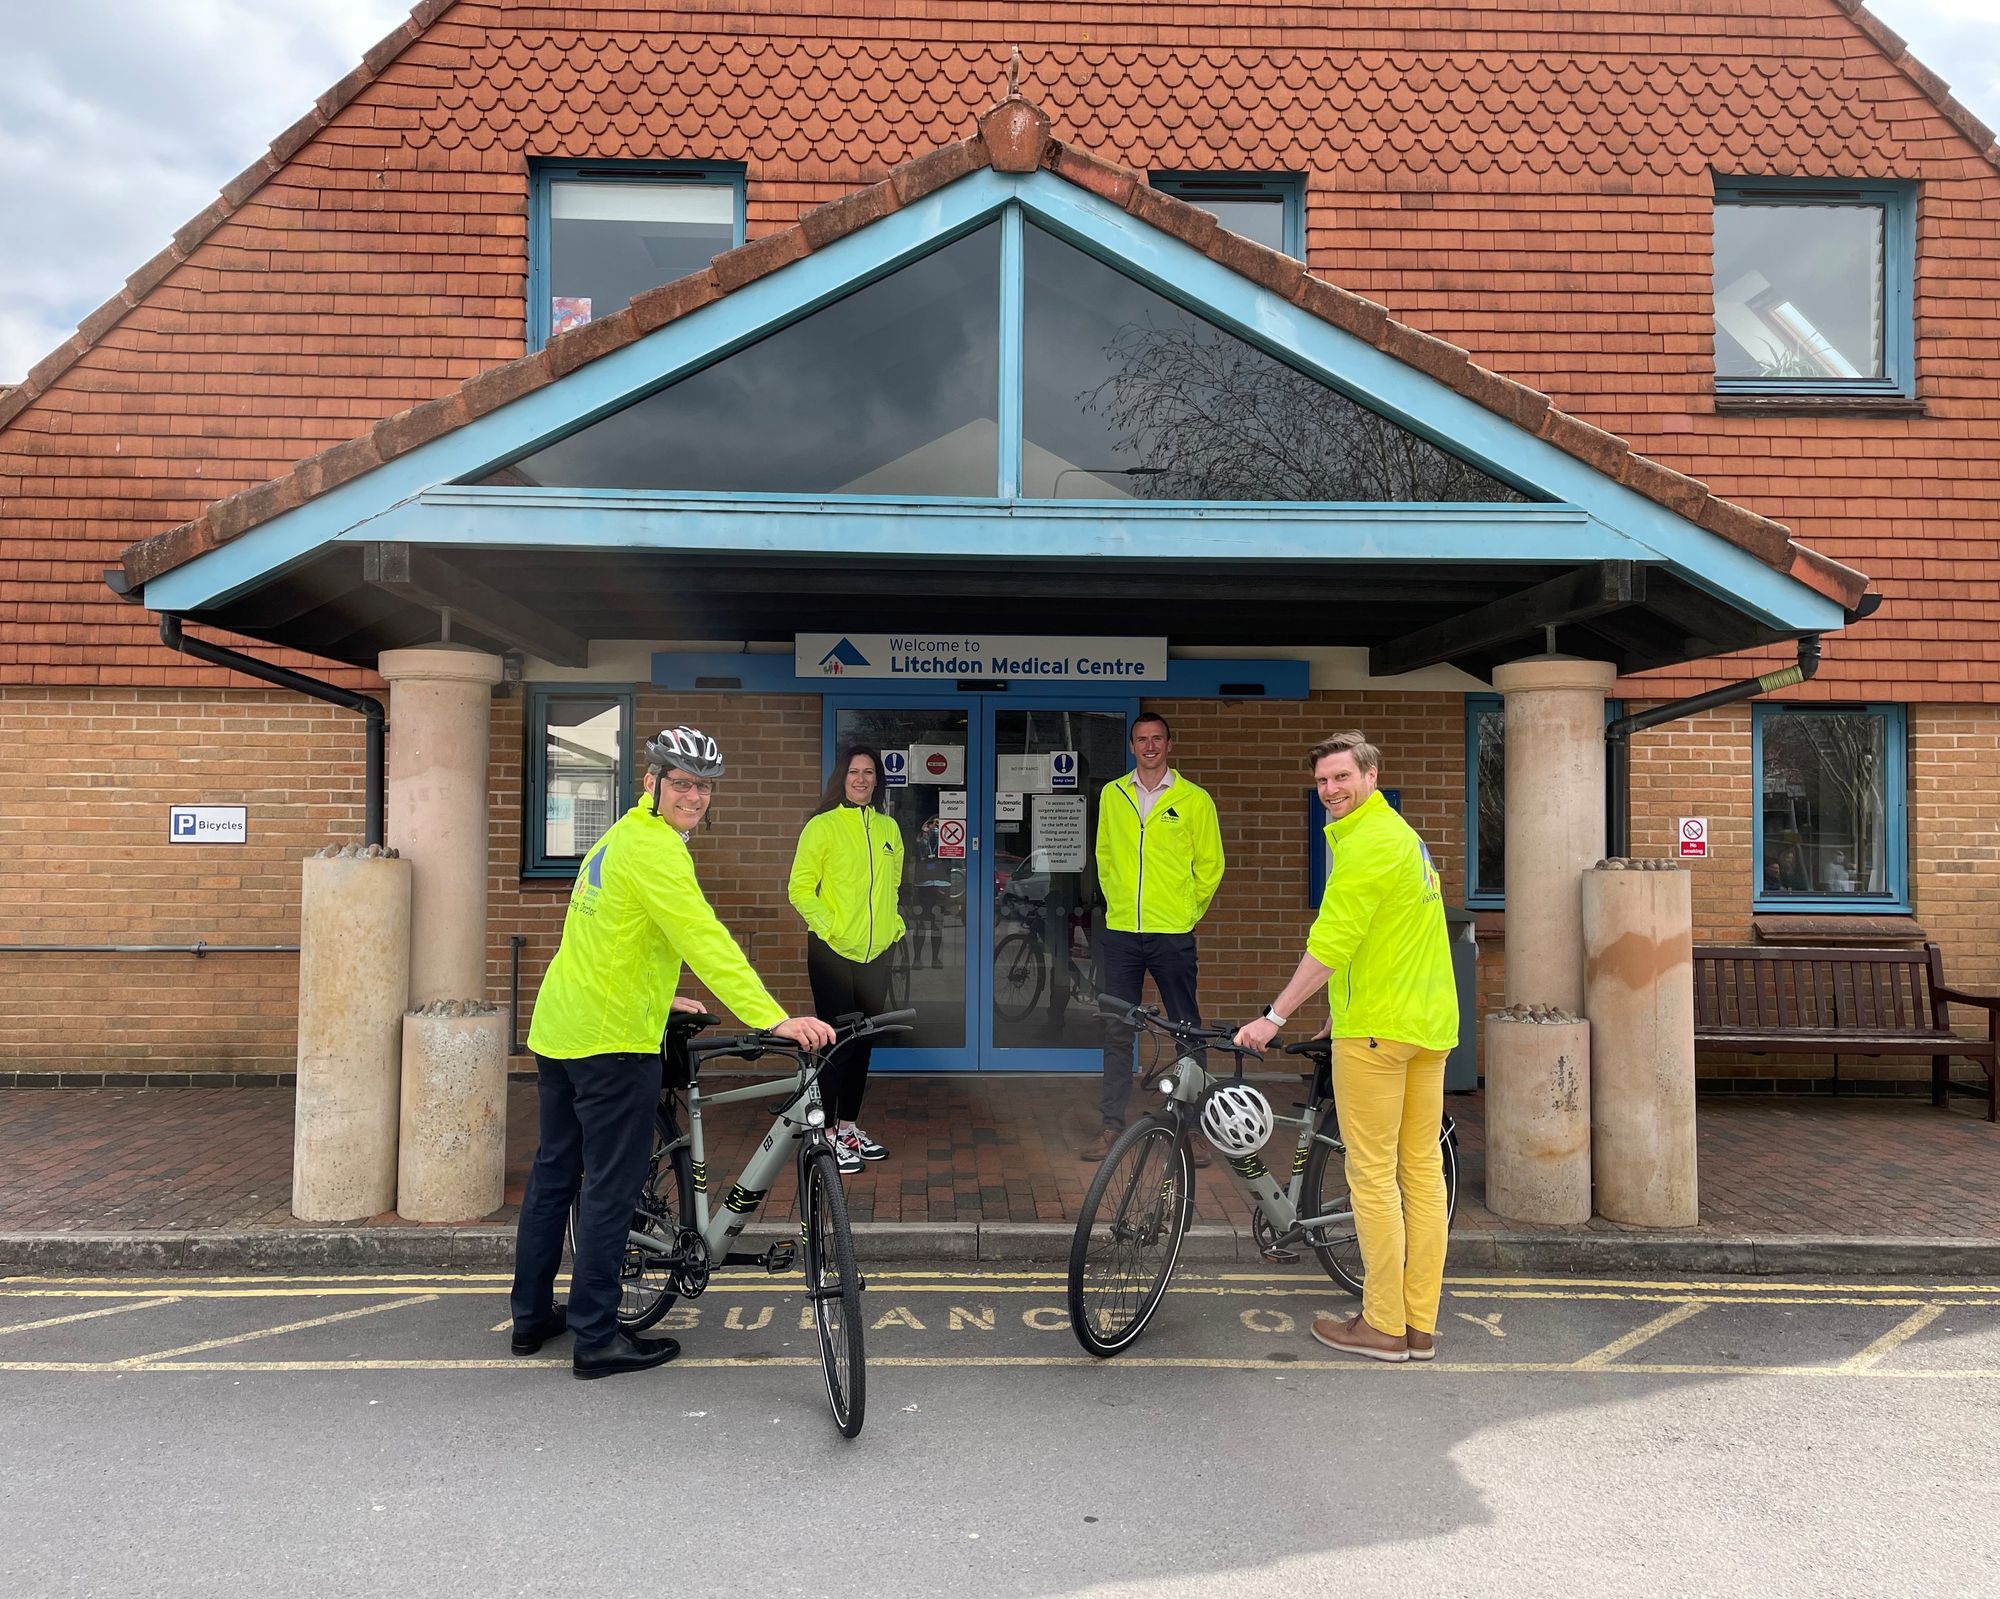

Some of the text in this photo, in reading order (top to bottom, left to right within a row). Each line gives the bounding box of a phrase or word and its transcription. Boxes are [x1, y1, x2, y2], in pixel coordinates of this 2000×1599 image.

[890, 638, 980, 653] Welcome to
[891, 656, 1145, 675] Litchdon Medical Centre
[178, 815, 243, 834] P Bicycles
[490, 1305, 1507, 1338] BULANCE OY
